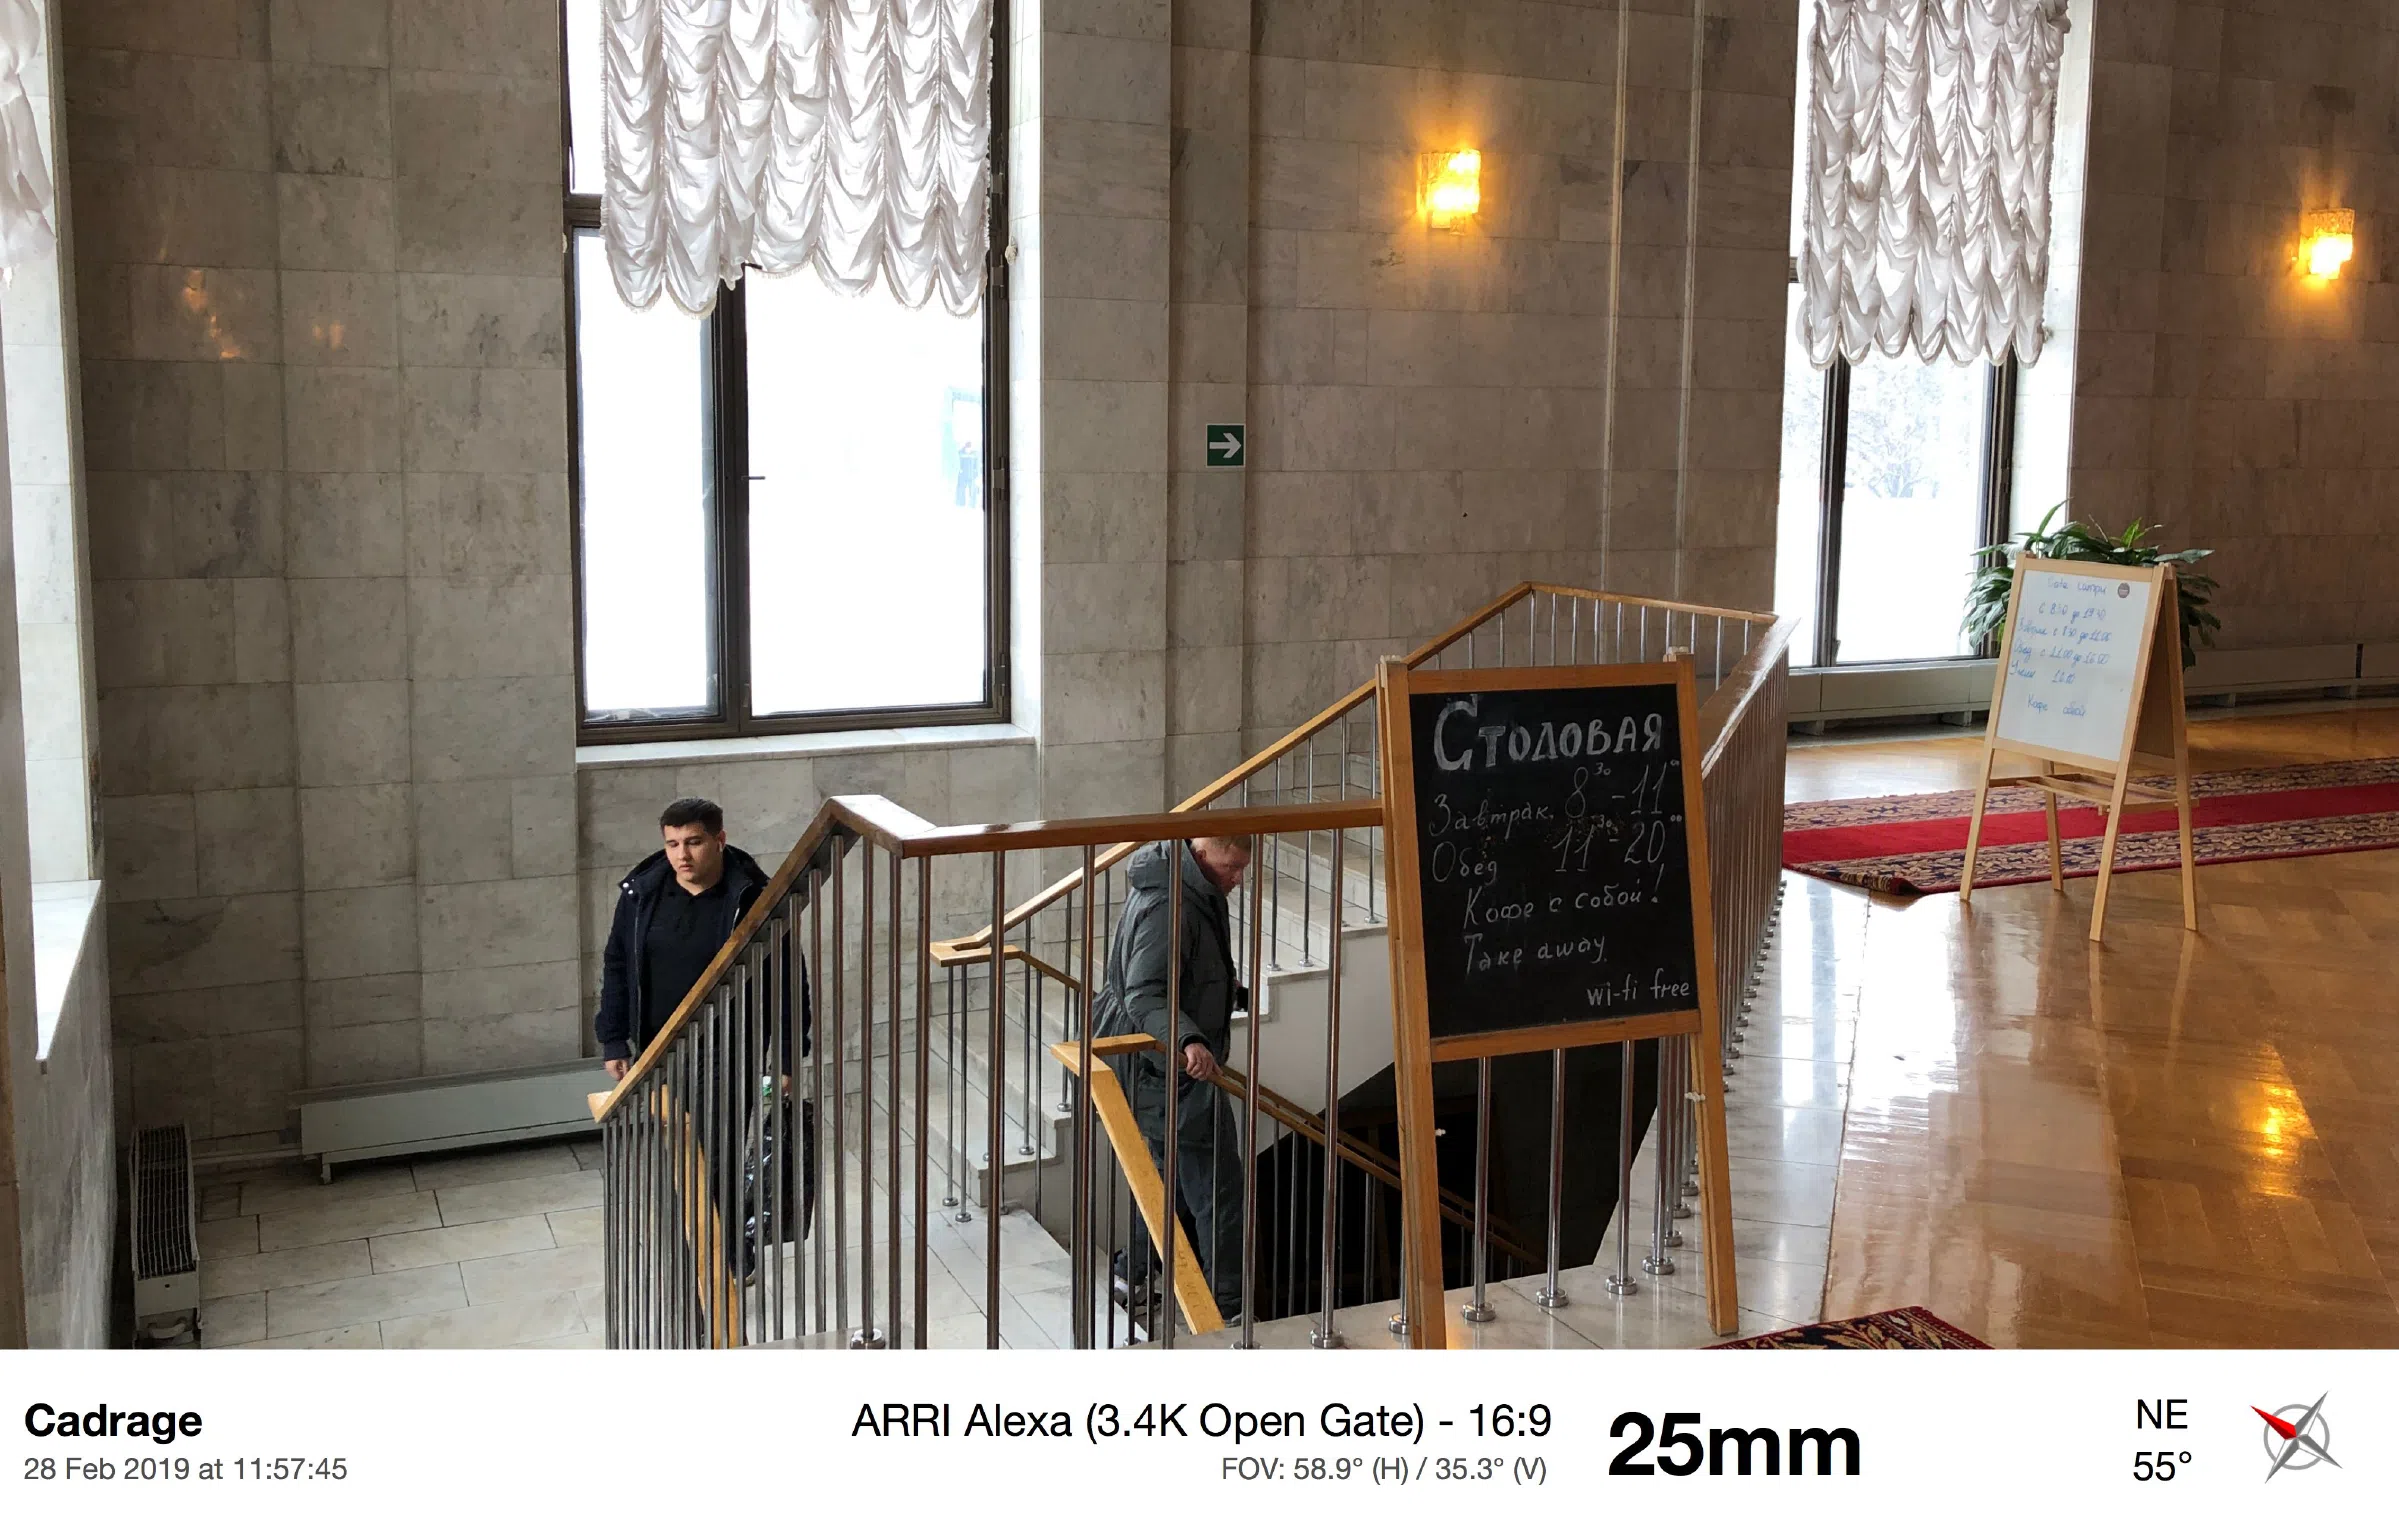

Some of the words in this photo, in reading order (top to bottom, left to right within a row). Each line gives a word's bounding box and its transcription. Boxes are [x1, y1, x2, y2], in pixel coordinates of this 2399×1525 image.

[1432, 841, 1498, 885] Обед
[1463, 886, 1534, 929] Кофе
[1549, 895, 1562, 913] с
[1650, 967, 1690, 999] free
